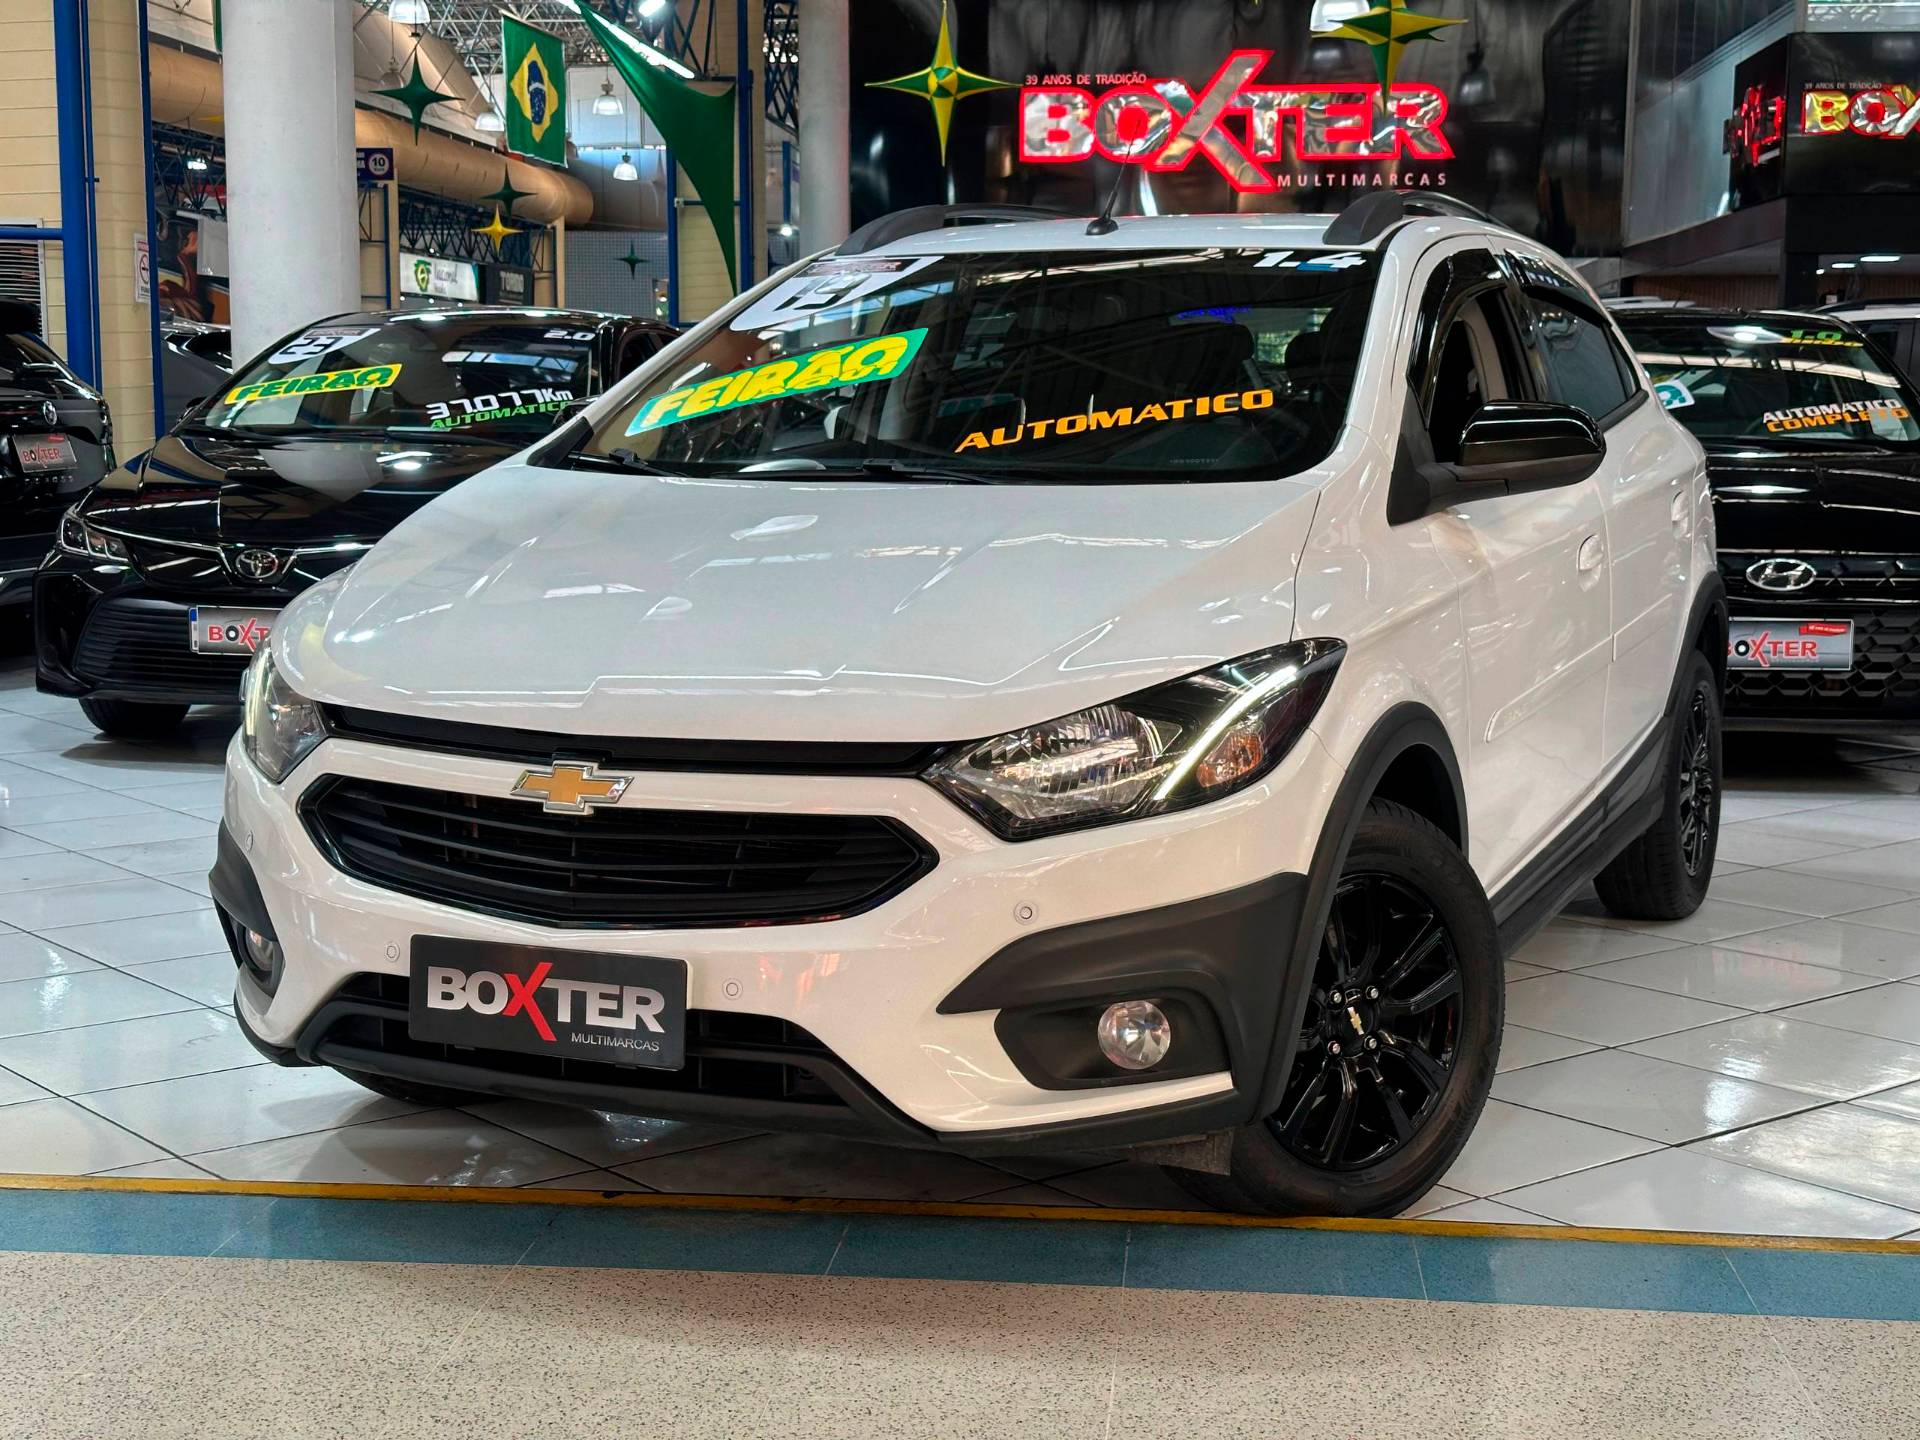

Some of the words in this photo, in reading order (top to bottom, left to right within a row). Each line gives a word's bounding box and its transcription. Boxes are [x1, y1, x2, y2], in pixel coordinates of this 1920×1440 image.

[1025, 74, 1038, 85] 39
[1043, 74, 1072, 85] ANOS
[1077, 74, 1090, 85] DE
[1096, 72, 1147, 86] TRADIÇÃO
[1019, 49, 1455, 194] BOXTER
[372, 157, 385, 167] 10
[1277, 173, 1447, 188] MULTIMARCAS
[1253, 251, 1367, 269] 1.4
[543, 330, 596, 341] 2.0
[279, 336, 343, 355] 23
[641, 337, 908, 427] FEIRÃO
[954, 389, 1273, 453] AUTOMATICO
[22, 441, 62, 467] BOXTER
[427, 962, 666, 1042] BOXTER
[571, 1032, 660, 1051] MULTIMARCAS
